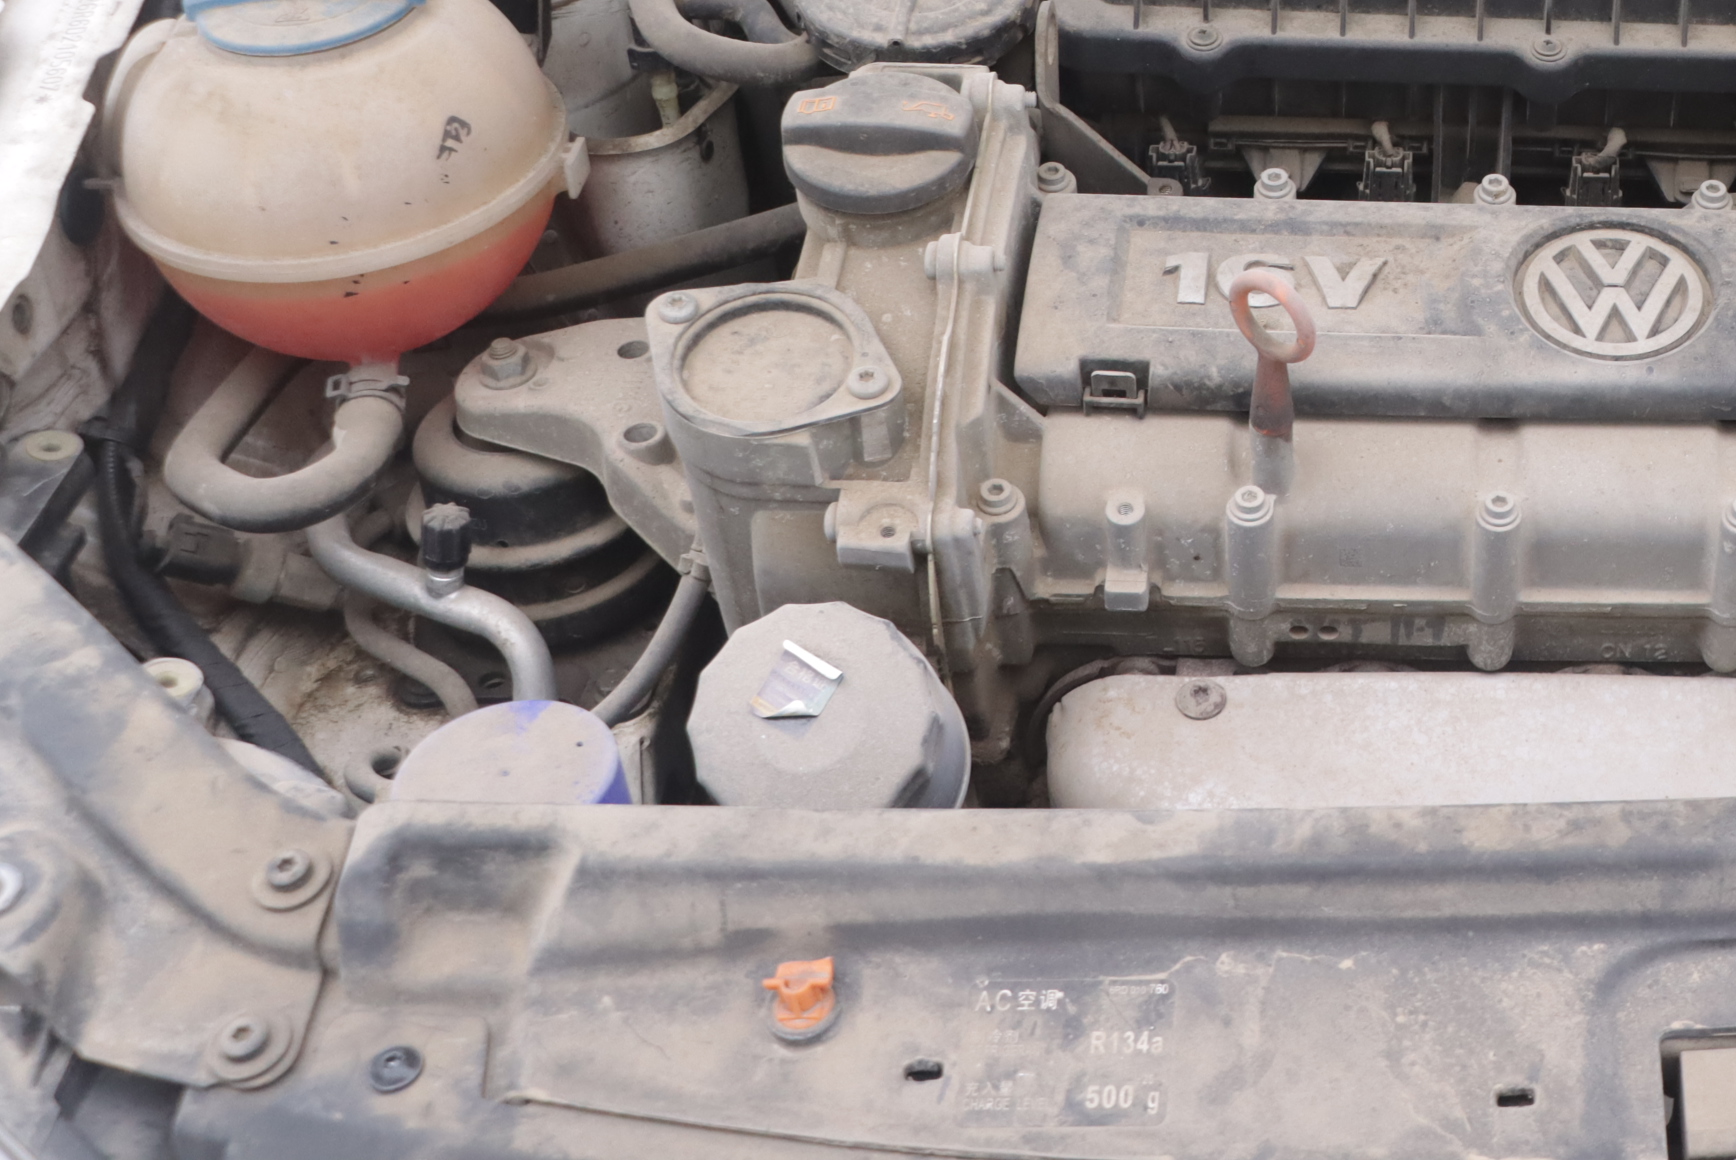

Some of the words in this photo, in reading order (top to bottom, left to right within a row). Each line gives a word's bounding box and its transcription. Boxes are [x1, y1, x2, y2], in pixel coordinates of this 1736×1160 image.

[1529, 233, 1697, 351] VW
[1149, 983, 1169, 994] 760
[1090, 1030, 1164, 1054] R134a
[962, 1097, 1010, 1111] CHARGE
[1084, 1085, 1134, 1109] 500
[1147, 1090, 1160, 1115] g
